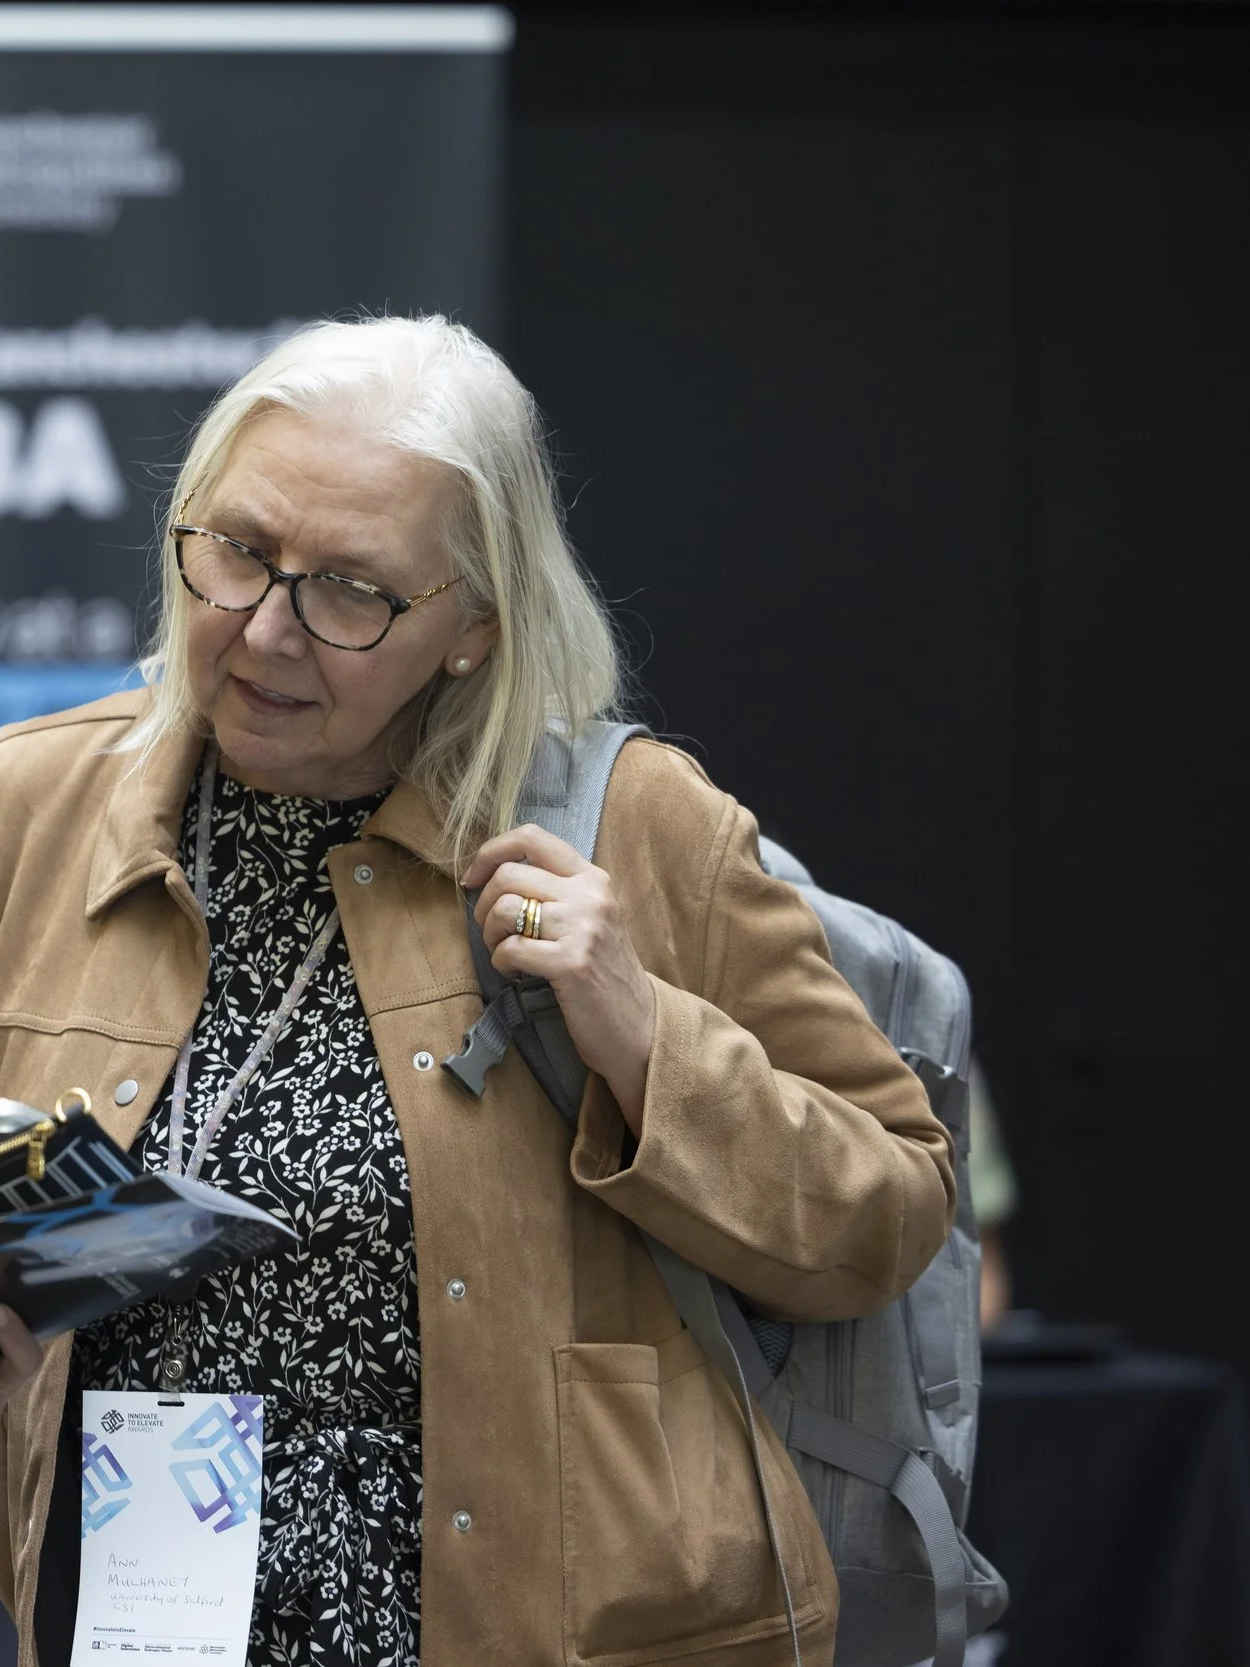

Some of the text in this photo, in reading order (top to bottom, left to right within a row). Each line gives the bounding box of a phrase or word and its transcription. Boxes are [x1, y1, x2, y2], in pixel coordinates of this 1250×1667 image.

[6, 594, 76, 658] at
[77, 608, 133, 658] a
[127, 1412, 158, 1420] INNOVATE
